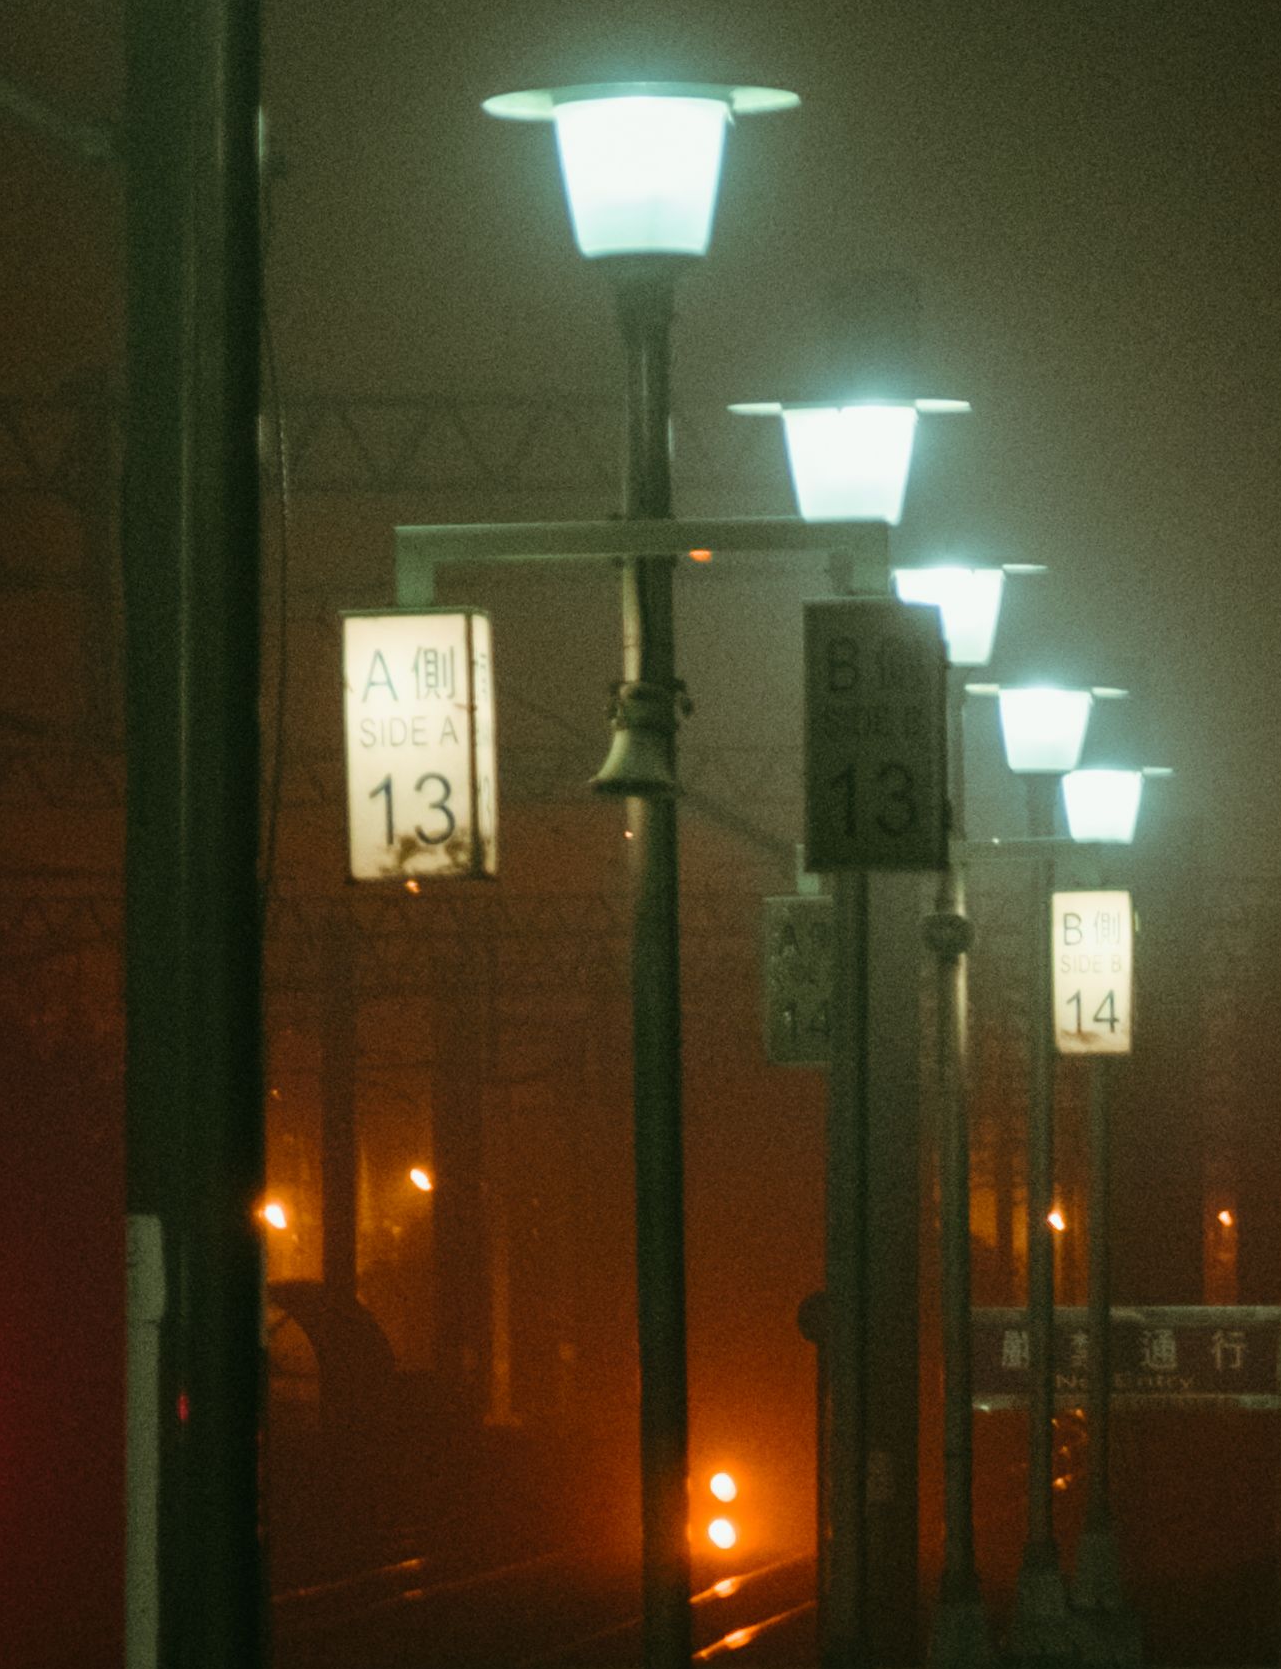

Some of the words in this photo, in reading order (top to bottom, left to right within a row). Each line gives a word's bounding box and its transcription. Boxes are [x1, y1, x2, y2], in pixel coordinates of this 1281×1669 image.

[361, 647, 398, 702] A
[411, 645, 456, 701] 側
[827, 637, 860, 693] B
[359, 715, 428, 749] SIDE
[439, 714, 459, 746] A
[368, 771, 456, 846] 13
[831, 763, 918, 839] 13
[1063, 912, 1084, 946] B
[1093, 910, 1121, 945] 側
[1059, 953, 1104, 974] SIDE
[1110, 953, 1123, 974] B
[781, 1000, 832, 1041] 14
[1066, 988, 1121, 1035] 14
[1113, 1372, 1196, 1391] Entry
